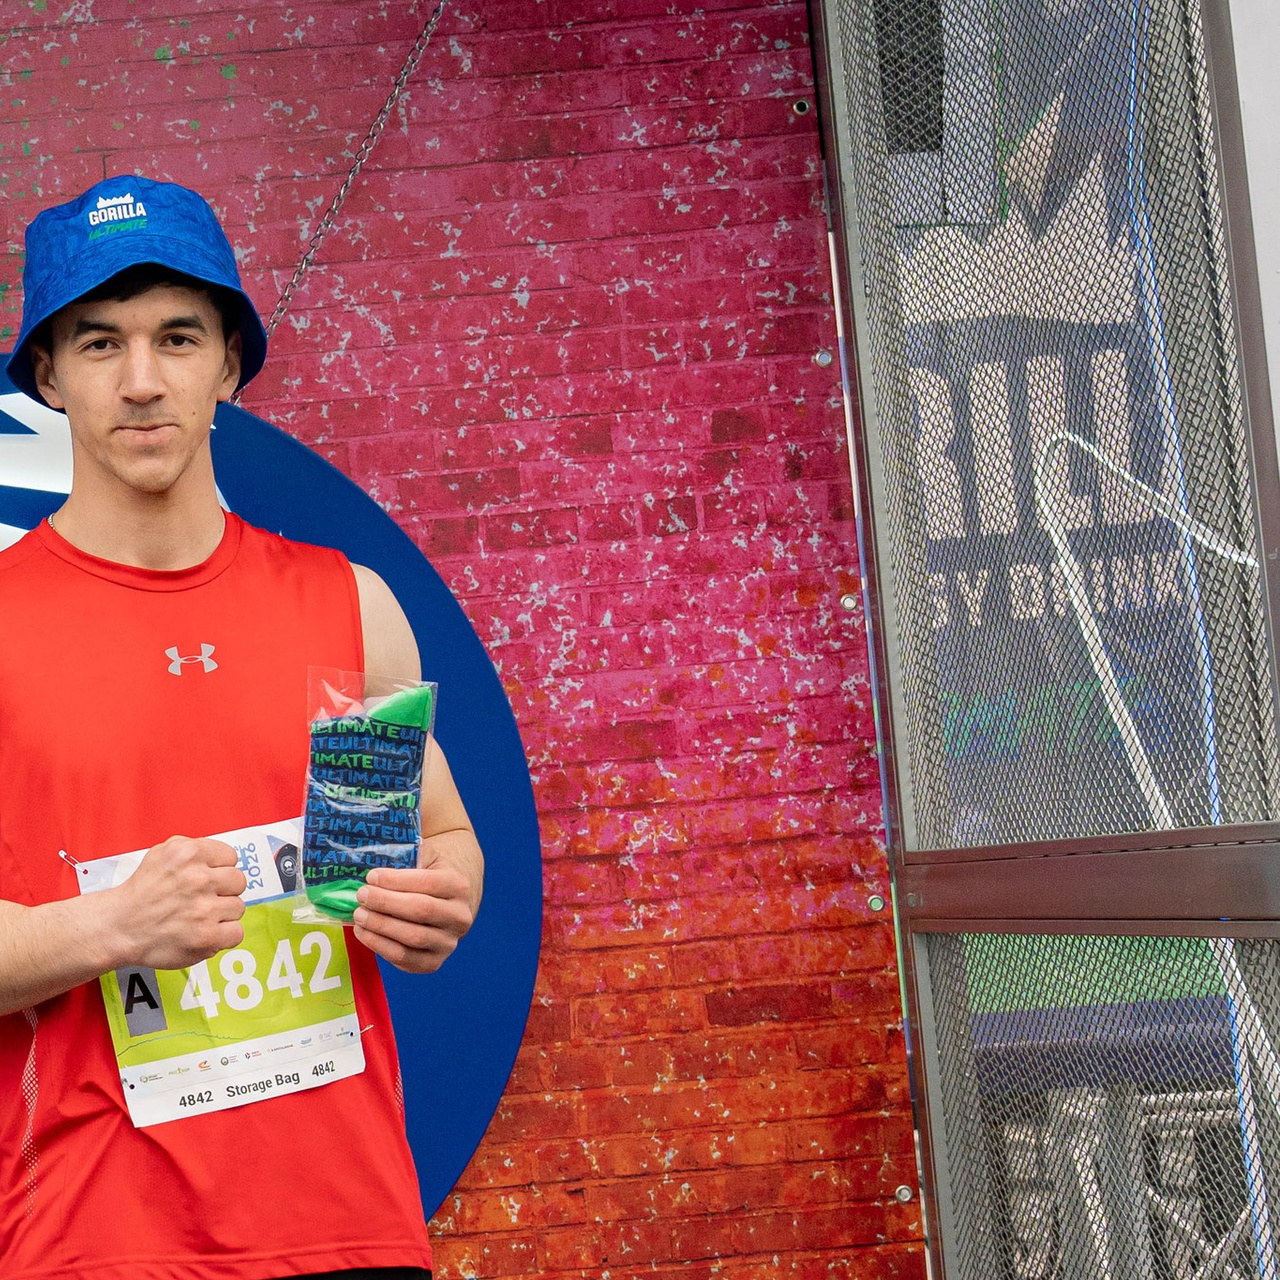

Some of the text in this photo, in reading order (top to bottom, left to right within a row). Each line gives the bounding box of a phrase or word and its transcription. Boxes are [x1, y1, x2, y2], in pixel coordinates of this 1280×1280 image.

[88, 202, 147, 226] GORILLA
[243, 842, 264, 890] 2026
[124, 972, 160, 1015] A
[179, 931, 342, 1019] 4842
[178, 1060, 336, 1108] 4842 Storage Bag 4842
